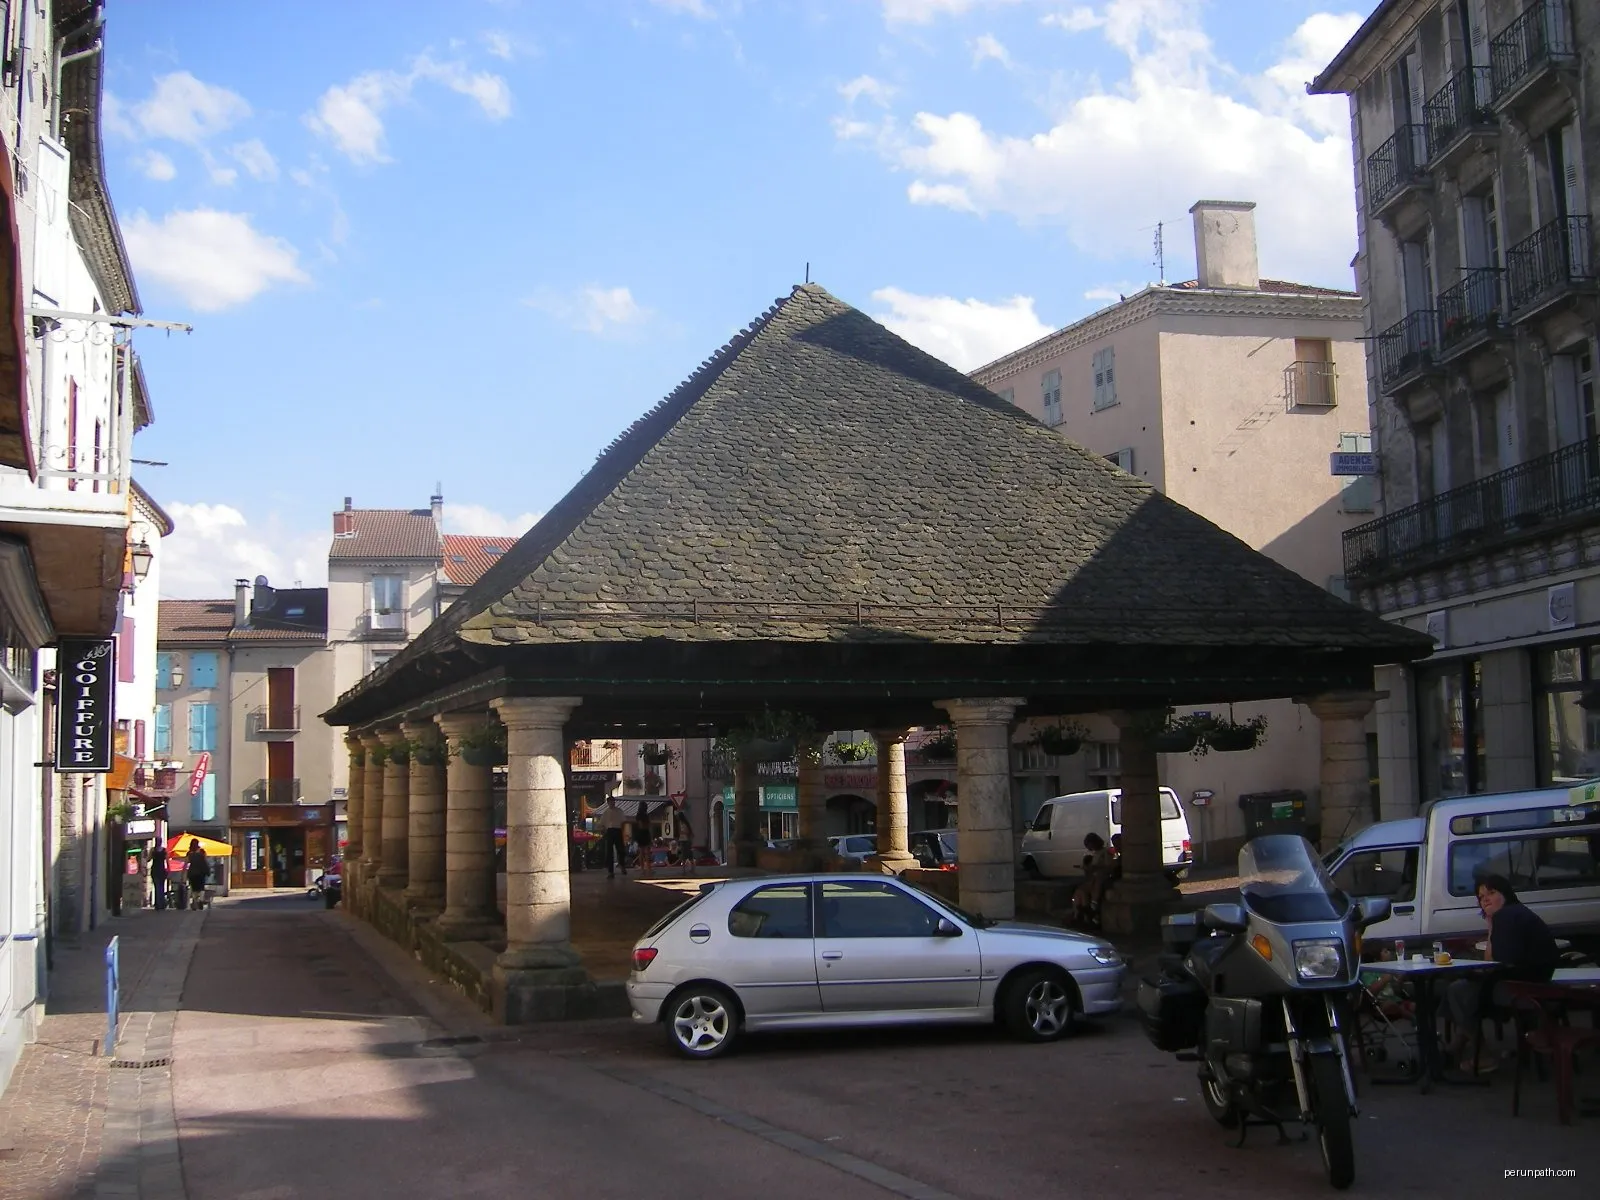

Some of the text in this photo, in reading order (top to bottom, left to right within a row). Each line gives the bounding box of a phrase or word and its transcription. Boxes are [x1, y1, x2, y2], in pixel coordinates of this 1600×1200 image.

[1338, 455, 1373, 465] AGENCE
[74, 660, 98, 762] COIFFURE
[191, 753, 209, 795] TABAC
[766, 792, 795, 800] OPTICIENS
